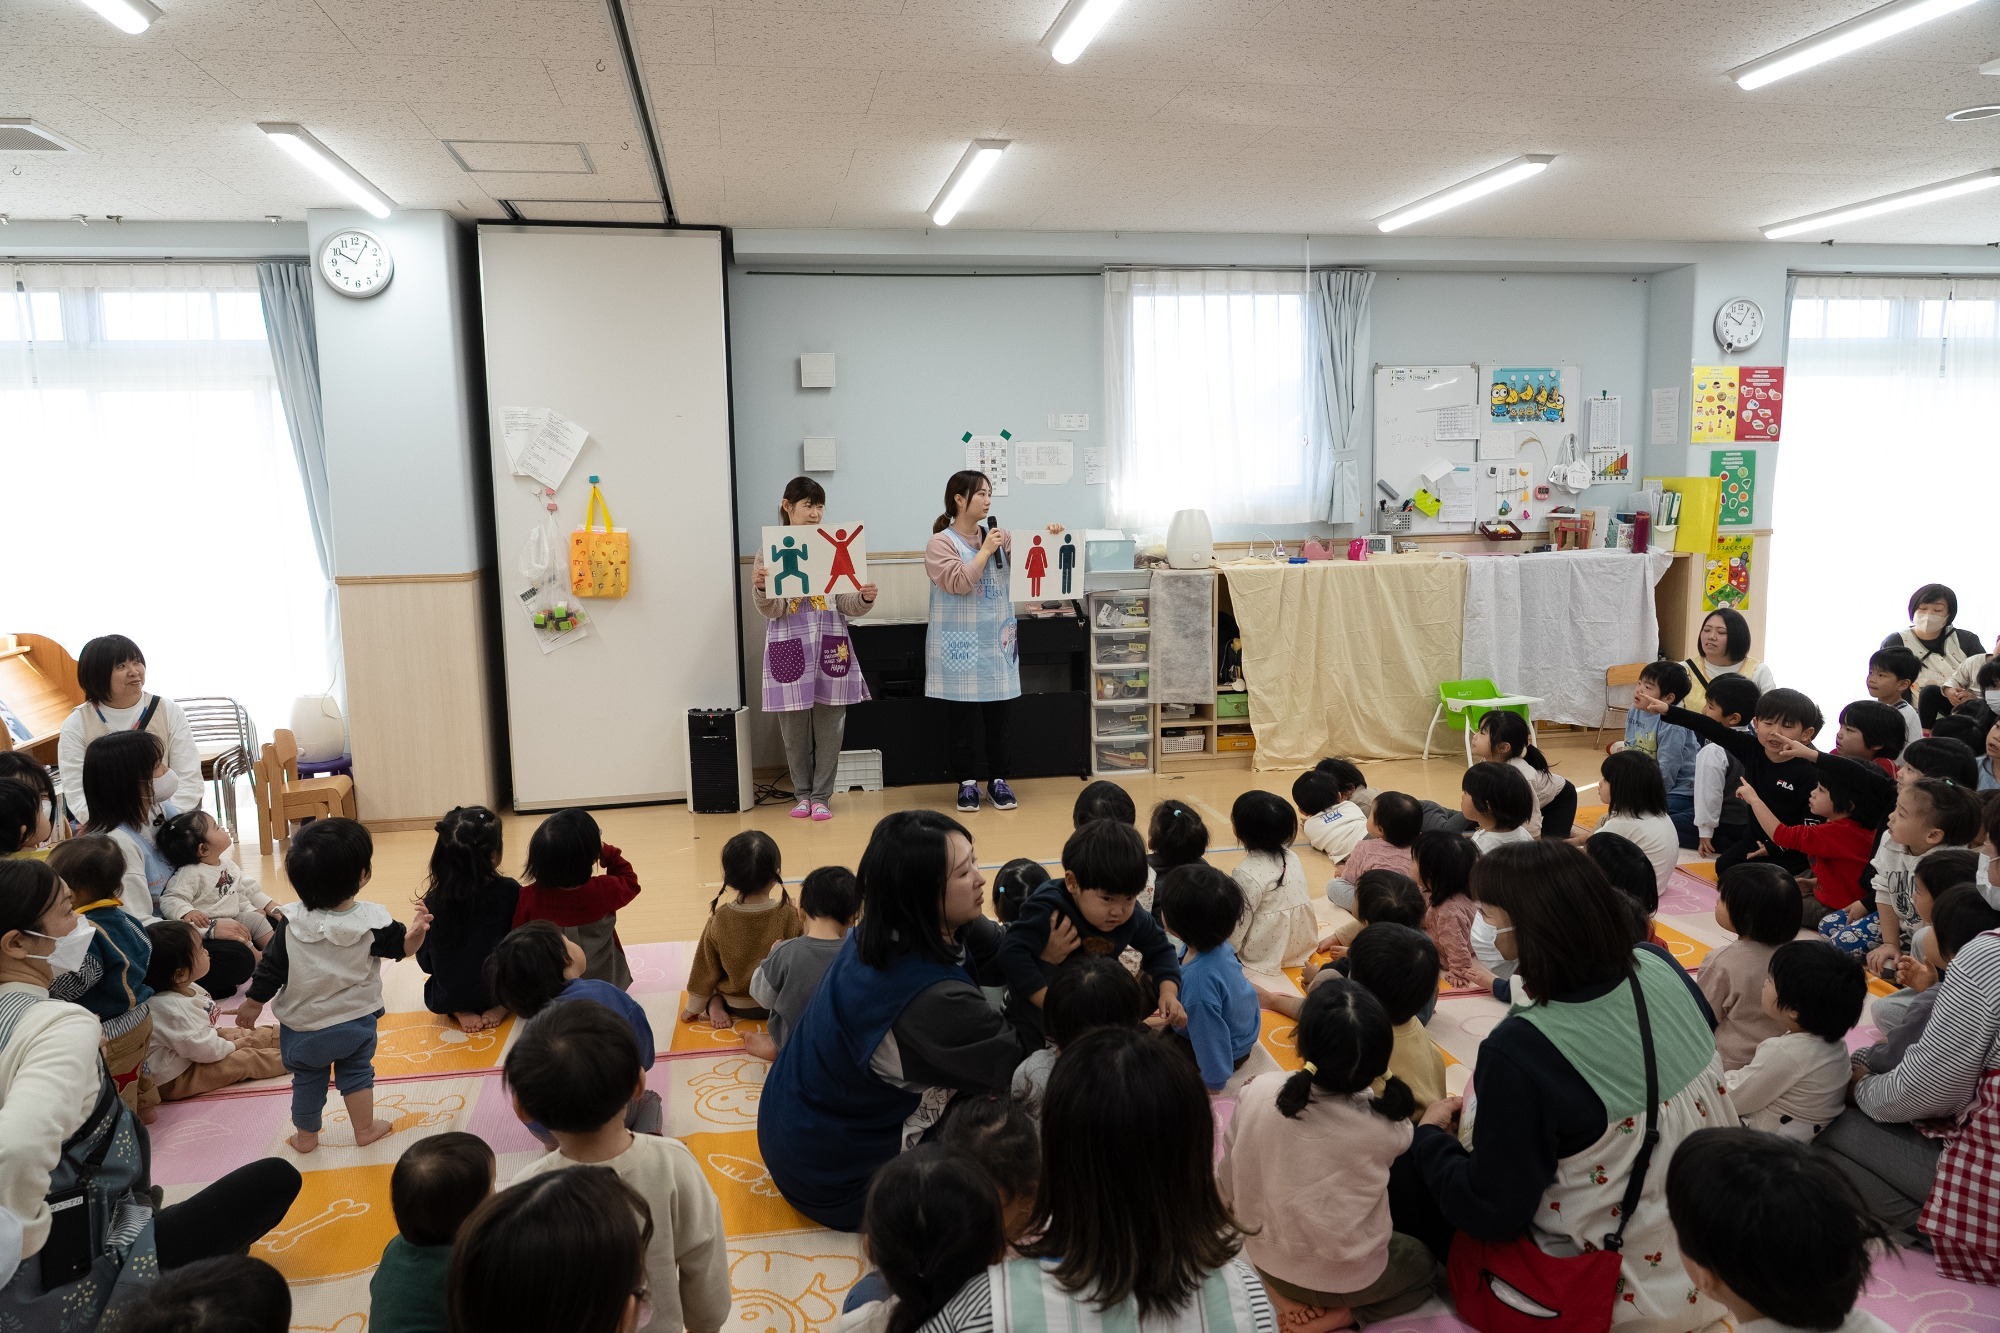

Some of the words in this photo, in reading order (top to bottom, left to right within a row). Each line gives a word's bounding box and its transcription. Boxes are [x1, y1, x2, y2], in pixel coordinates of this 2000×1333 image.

[341, 240, 347, 248] 11
[351, 237, 359, 245] 12
[333, 248, 340, 256] 10
[372, 248, 378, 256] 2
[332, 258, 337, 267] 9
[336, 269, 341, 277] 8
[344, 277, 349, 285] 7
[356, 280, 360, 288] 6
[367, 277, 372, 285] 5
[831, 664, 846, 673] HAPPY
[1776, 780, 1794, 790] FILA
